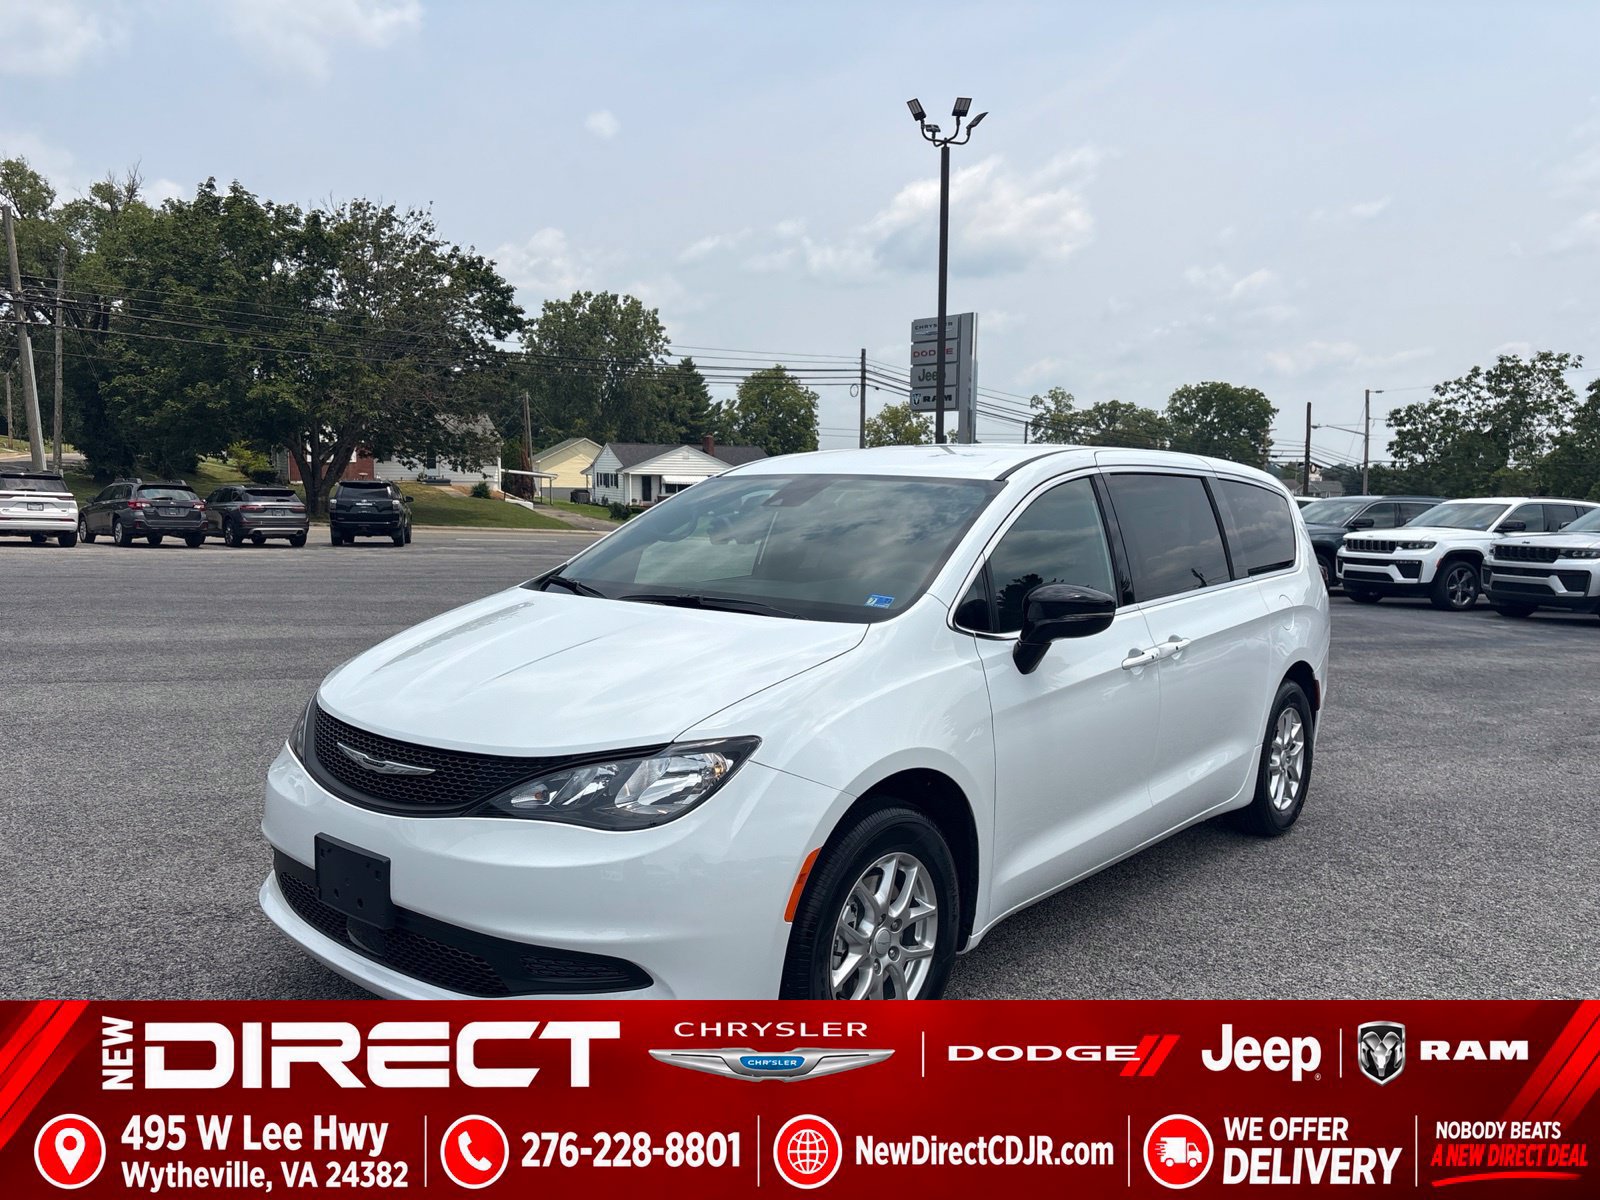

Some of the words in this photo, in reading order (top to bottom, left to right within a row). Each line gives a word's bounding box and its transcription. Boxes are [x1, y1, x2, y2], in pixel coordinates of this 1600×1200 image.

[914, 321, 953, 330] CHRYSR
[913, 347, 954, 358] DODE
[918, 368, 946, 382] Jee
